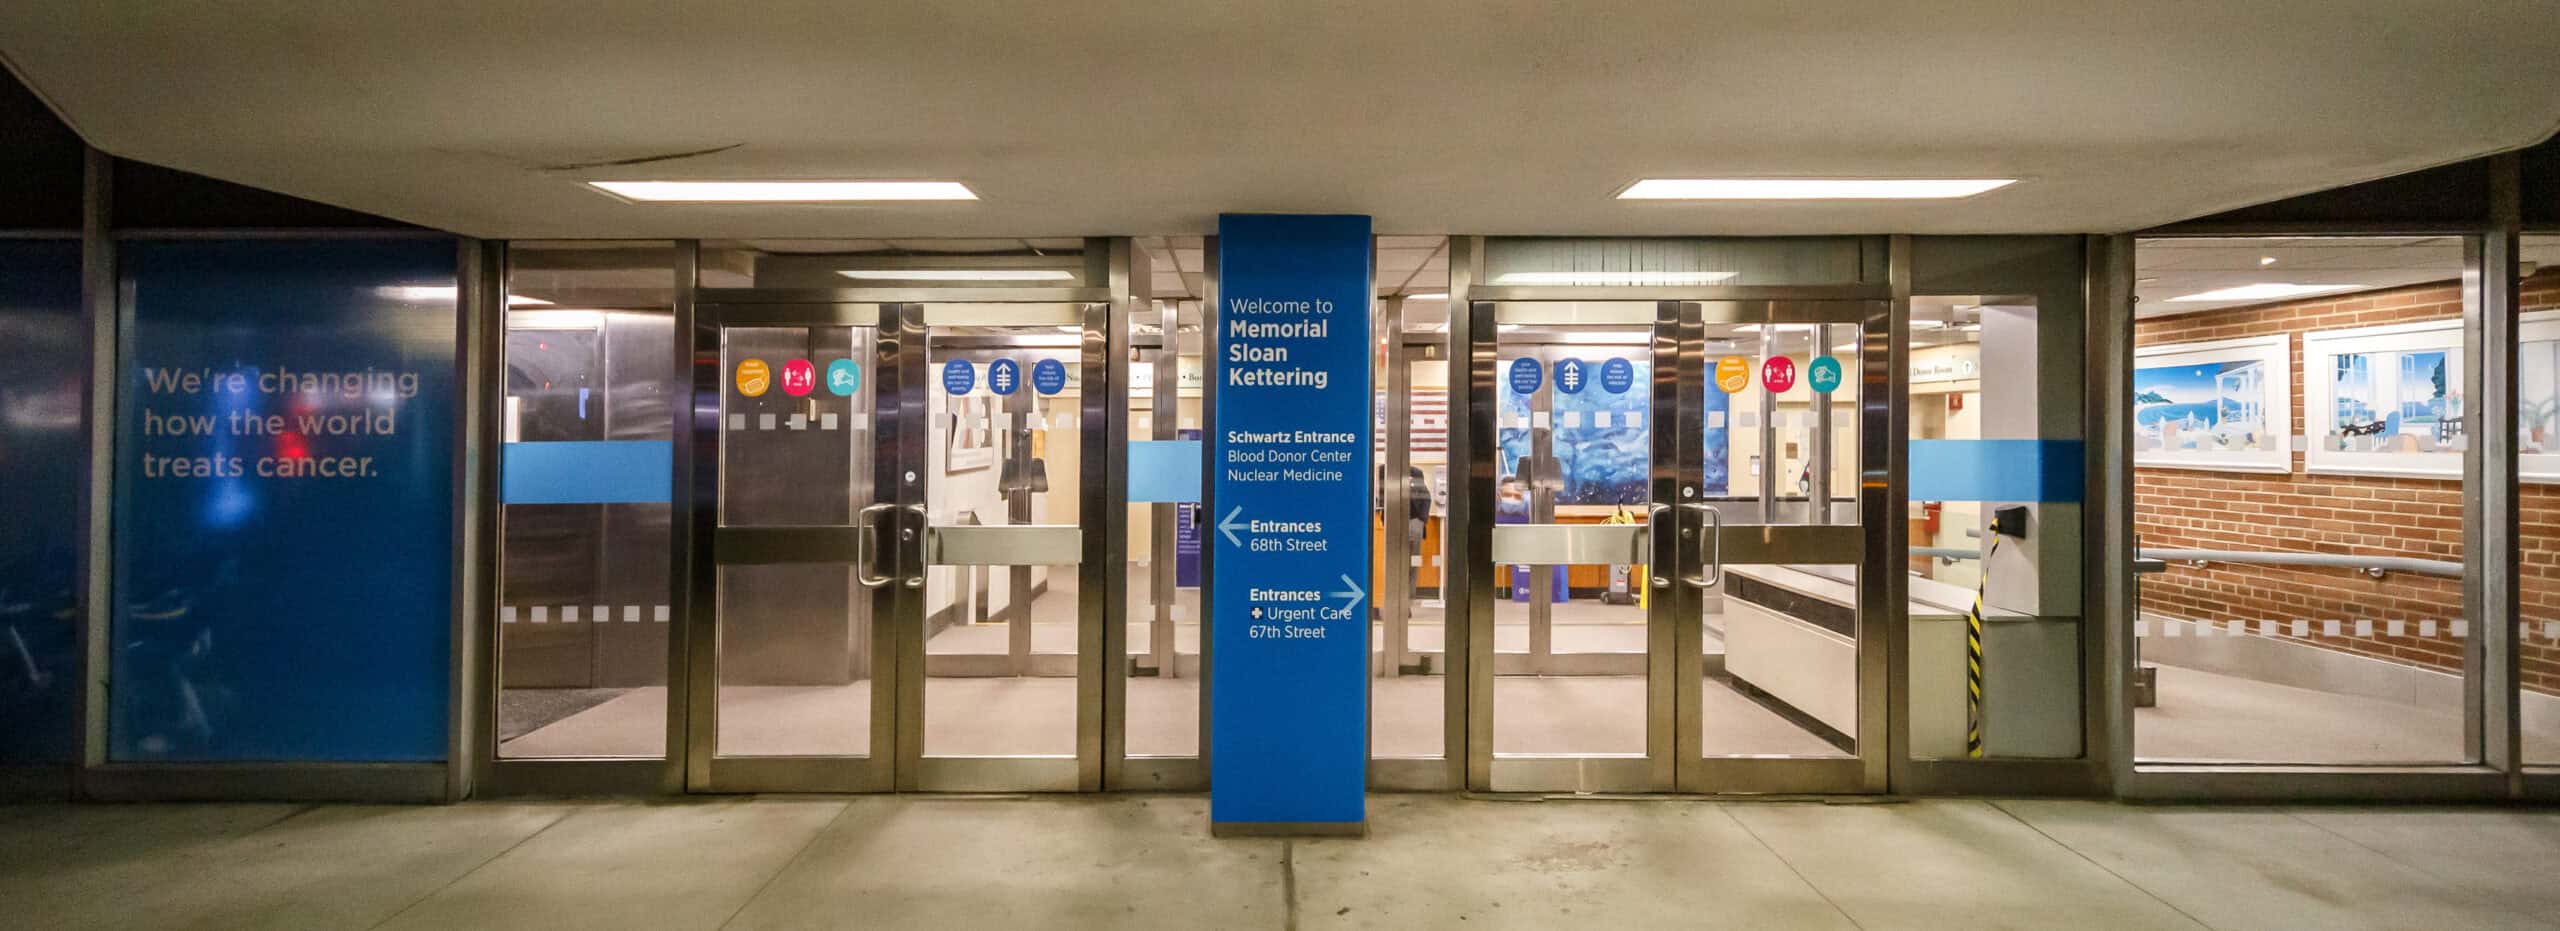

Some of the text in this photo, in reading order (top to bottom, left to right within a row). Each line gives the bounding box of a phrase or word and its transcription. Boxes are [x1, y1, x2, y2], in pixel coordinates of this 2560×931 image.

[1230, 298, 1333, 314] Welcome to
[1229, 319, 1328, 338] Memorial
[1229, 343, 1287, 362] Sloan
[145, 366, 419, 399] We're changing
[1229, 367, 1328, 389] Kettering
[145, 408, 395, 436] how the world
[1228, 431, 1355, 443] Schwartz Entrance
[1228, 450, 1352, 462] Blood Donor Center
[144, 452, 378, 478] treats cancer.
[1228, 469, 1343, 482] Nuclear Medicine
[1250, 520, 1322, 533] Entrances
[1250, 538, 1328, 552] 68th Street
[1250, 588, 1321, 602] Entrances
[1267, 607, 1352, 622] Urgent Care
[1249, 625, 1326, 639] 67th Street
